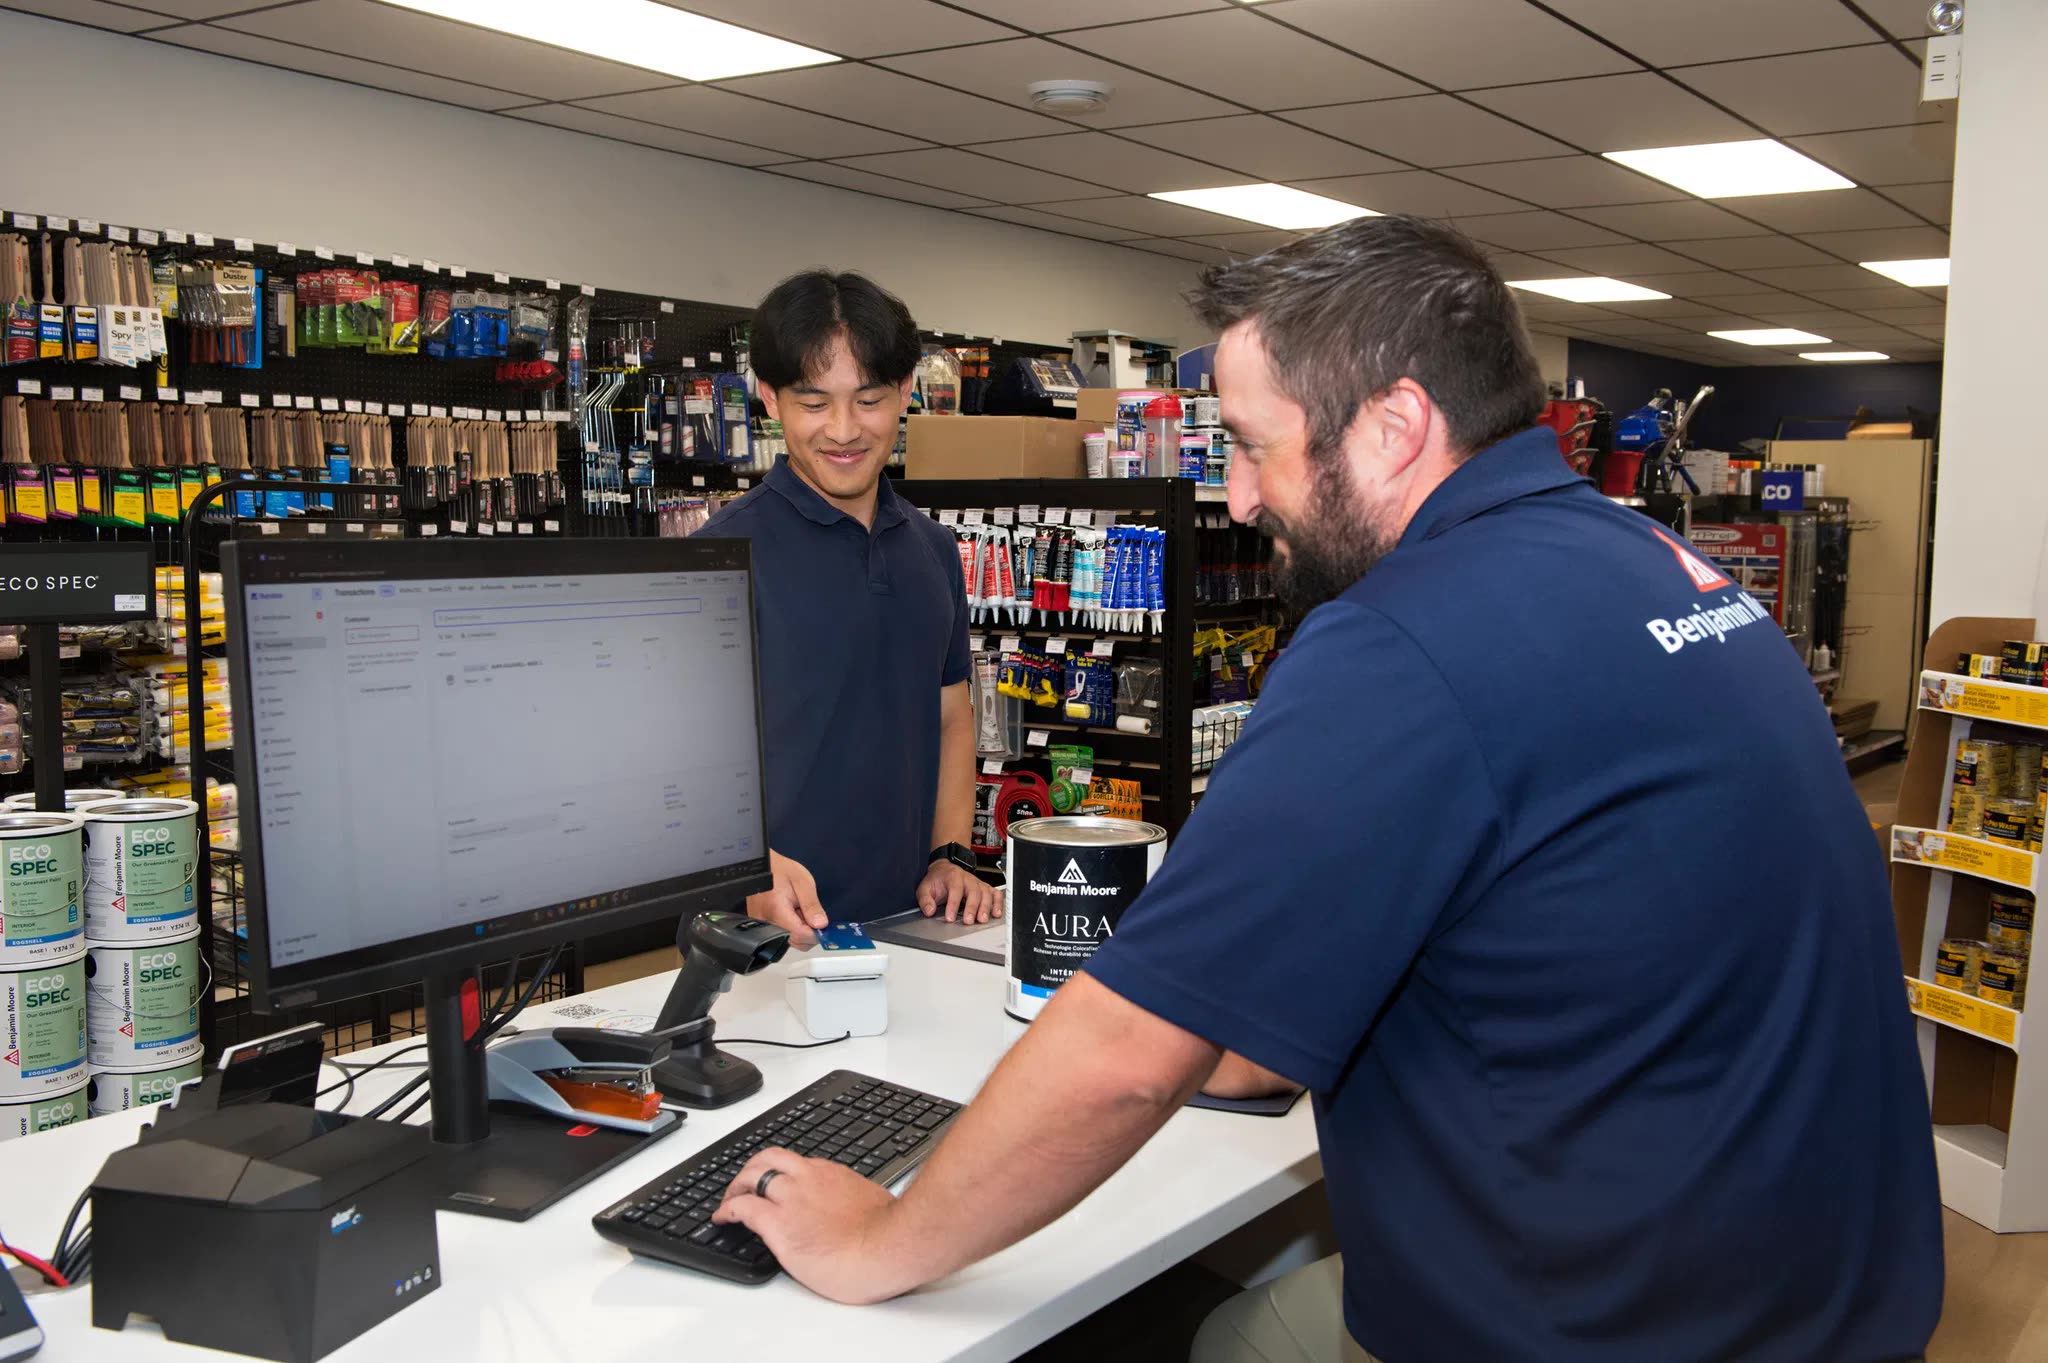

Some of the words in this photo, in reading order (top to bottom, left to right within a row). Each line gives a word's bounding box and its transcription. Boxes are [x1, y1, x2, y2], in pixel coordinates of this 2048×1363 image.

[223, 272, 247, 281] Duster
[111, 330, 132, 342] Spry
[0, 577, 38, 590] ECO
[46, 576, 97, 589] SPEC
[1646, 596, 1757, 654] Benjamin
[131, 827, 170, 844] ECO
[9, 844, 51, 861] ECO
[132, 841, 176, 857] SPEC
[10, 859, 57, 876] SPEC
[115, 861, 124, 896] Benjamin
[1030, 880, 1077, 896] Benjamin
[1081, 885, 1117, 896] Moore
[1033, 912, 1113, 938] AURA
[1044, 943, 1071, 951] Technologie
[140, 952, 177, 969] ECO
[140, 965, 182, 982] SPEC
[26, 974, 65, 993] ECO
[26, 988, 70, 1008] SPEC
[123, 989, 132, 1022] Benjamin
[8, 1013, 18, 1049] Benjamin
[28, 1067, 58, 1076] EGGSHELL
[139, 1076, 176, 1094] ECO
[140, 1091, 172, 1106] SPE
[38, 1102, 73, 1123] ECO
